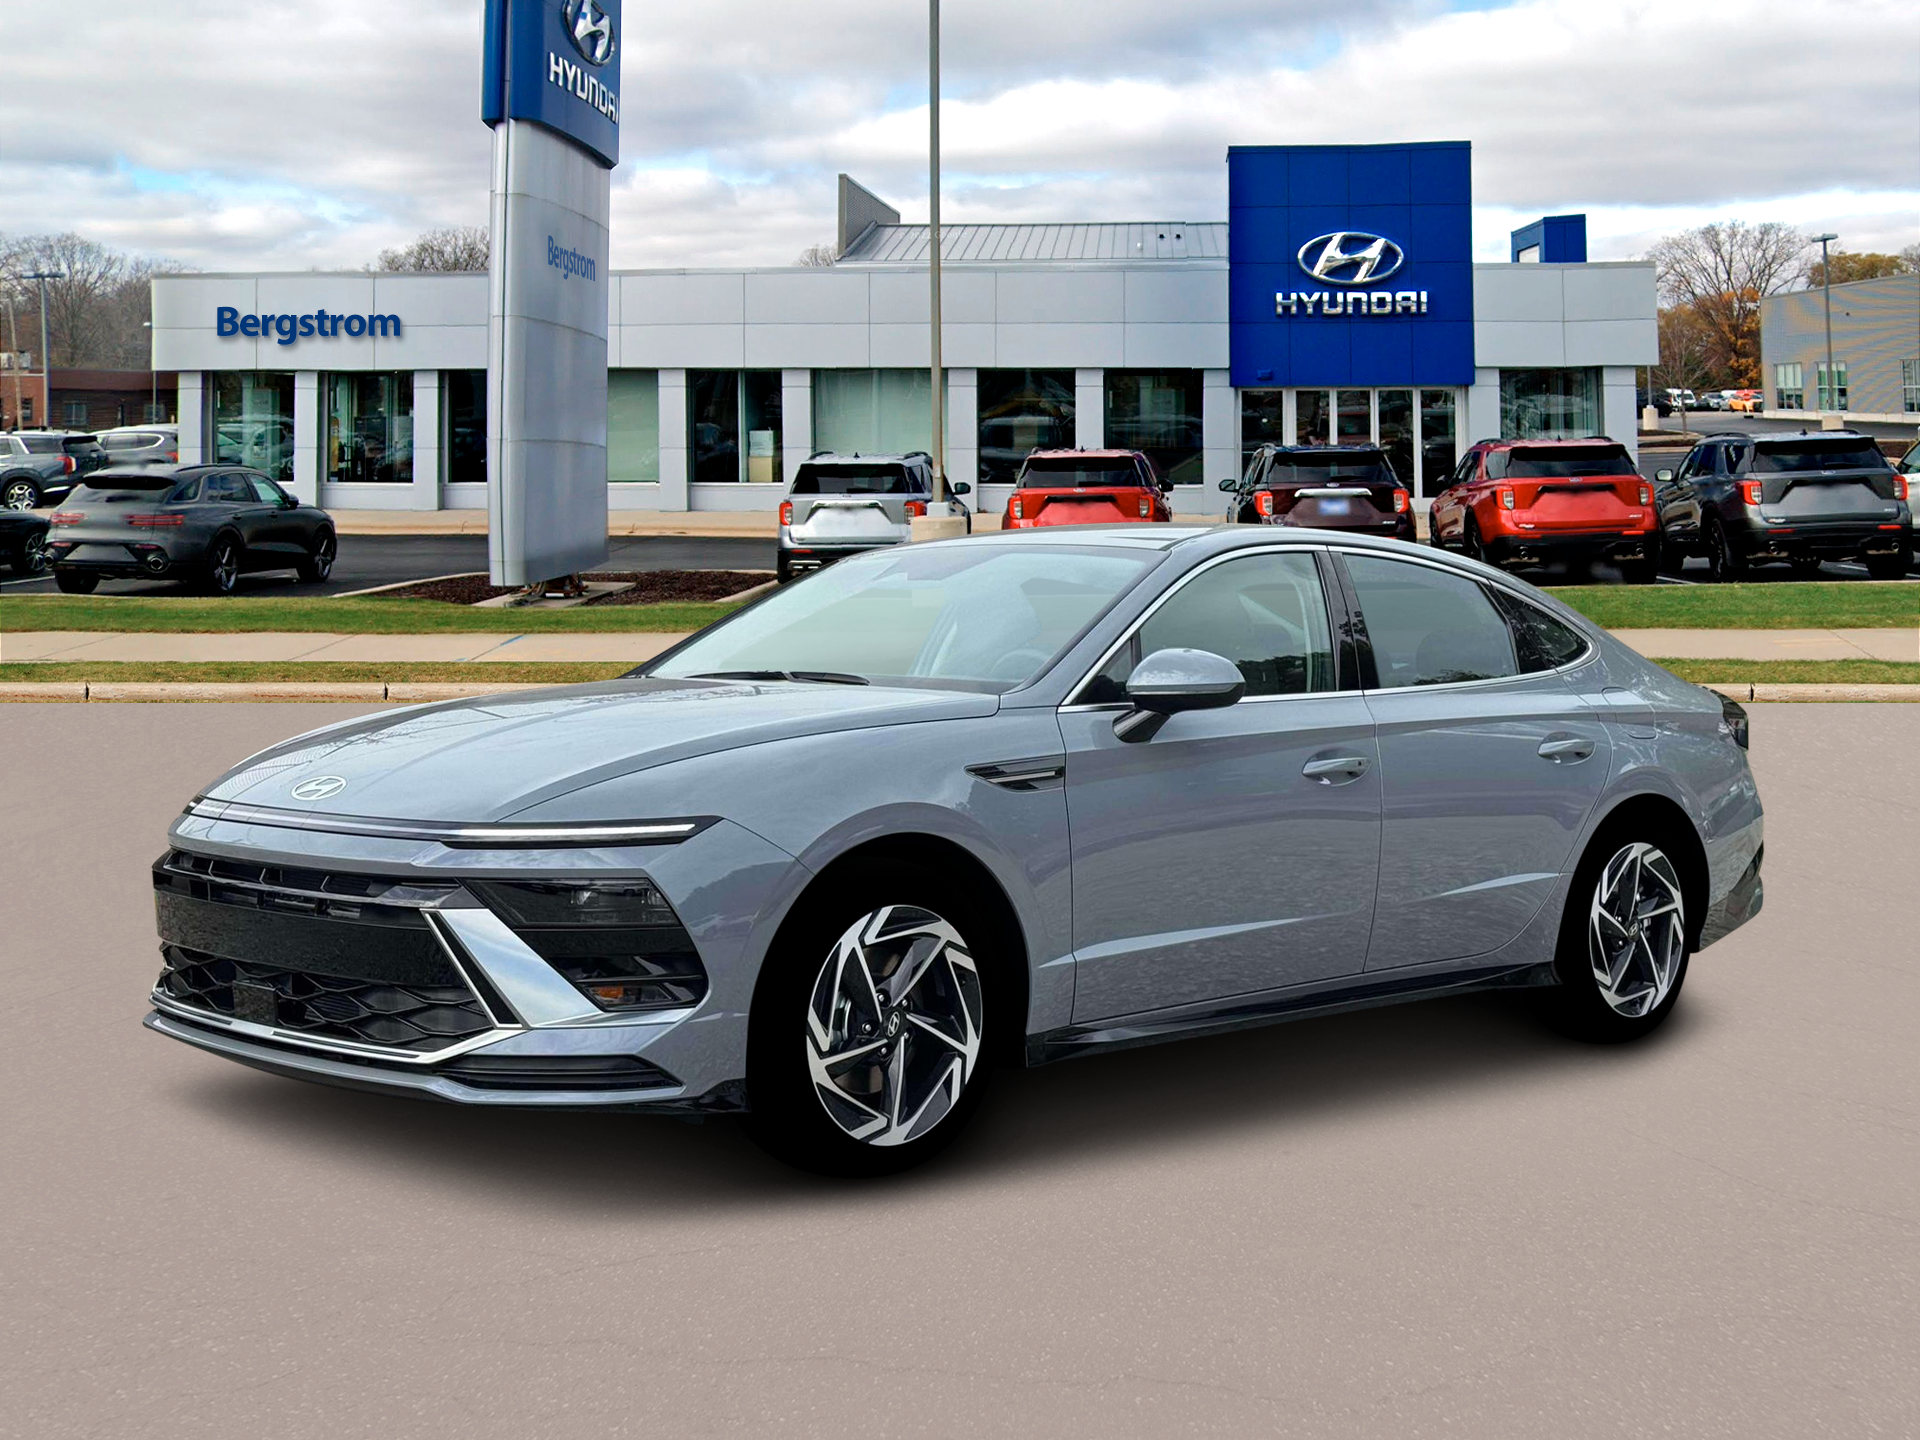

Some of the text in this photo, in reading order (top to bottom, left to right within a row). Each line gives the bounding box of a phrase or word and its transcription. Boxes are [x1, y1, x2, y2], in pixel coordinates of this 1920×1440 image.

[548, 52, 619, 124] HYUNDAI
[547, 235, 596, 281] Bergstrom
[1276, 291, 1428, 315] HYUNDAI
[216, 306, 402, 345] Bergstrom
